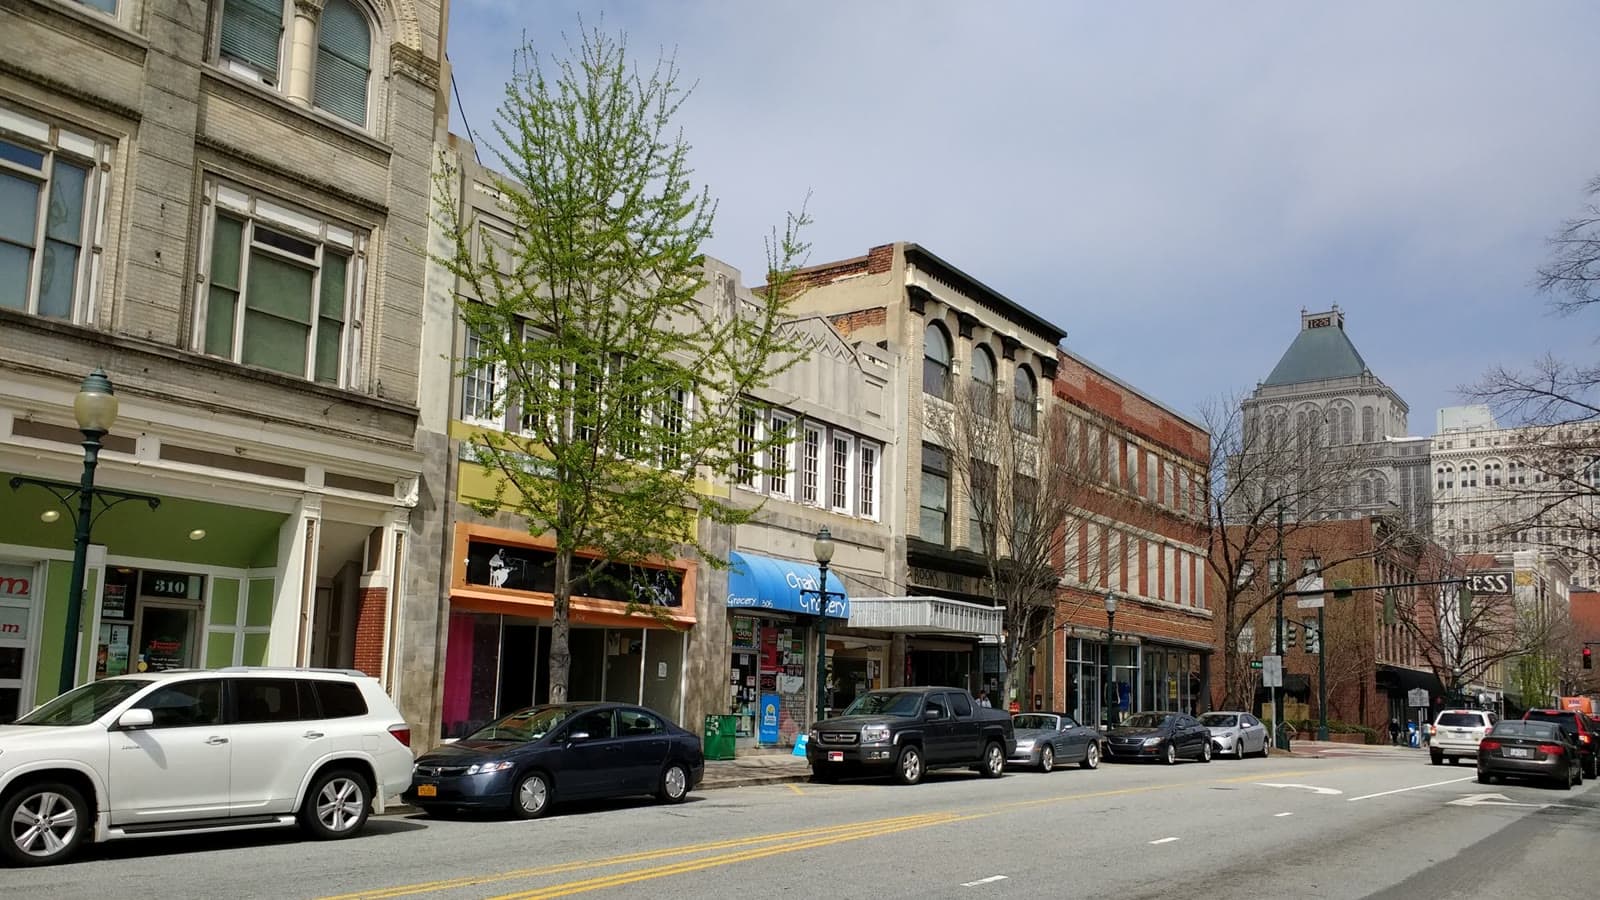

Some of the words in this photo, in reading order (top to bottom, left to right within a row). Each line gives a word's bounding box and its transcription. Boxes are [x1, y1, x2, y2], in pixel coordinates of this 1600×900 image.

[914, 567, 938, 587] BOOKS
[154, 579, 185, 593] 310
[727, 593, 757, 606] Grocery
